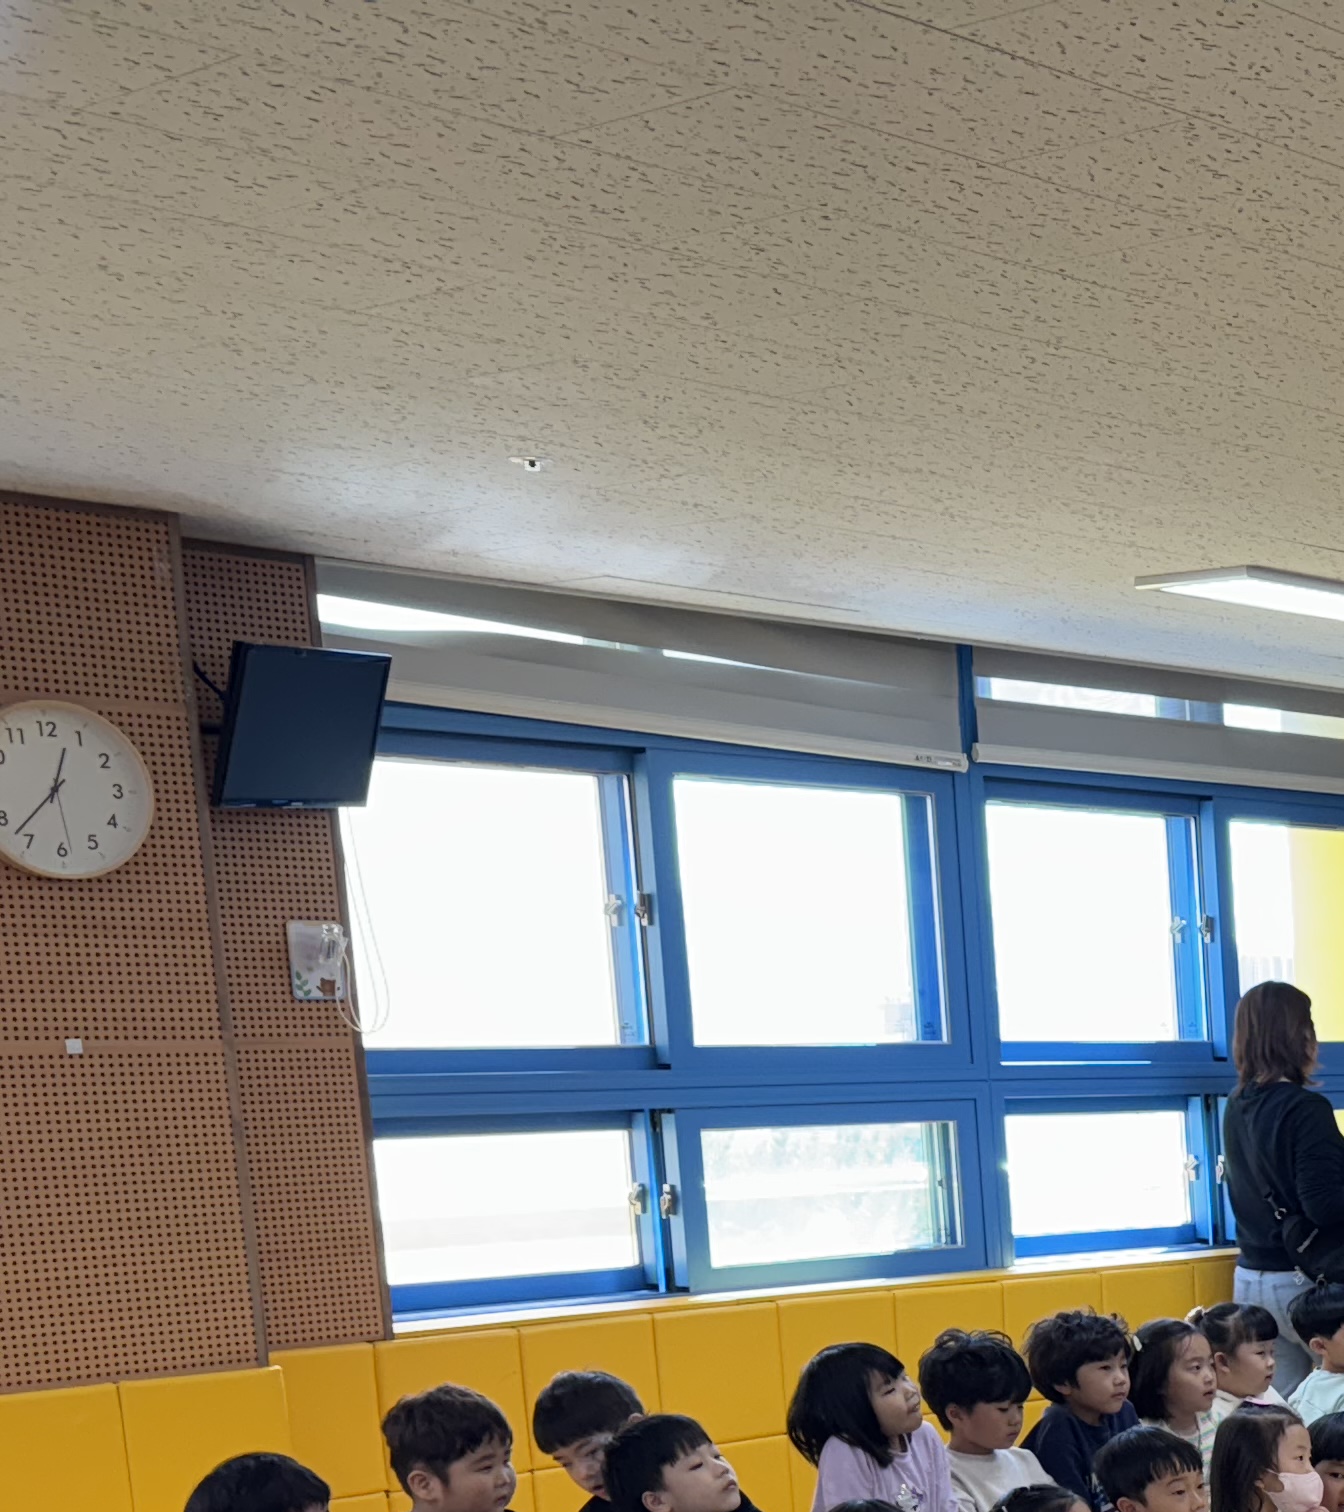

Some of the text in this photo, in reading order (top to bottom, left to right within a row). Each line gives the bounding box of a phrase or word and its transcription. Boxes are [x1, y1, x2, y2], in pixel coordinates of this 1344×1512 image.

[5, 728, 25, 744] 11
[36, 720, 57, 738] 12
[75, 731, 82, 747] 1
[98, 753, 111, 769] 2
[112, 783, 124, 799] 3
[107, 813, 119, 829] 4
[23, 833, 35, 849] 7
[88, 834, 99, 850] 5
[56, 842, 68, 857] 6
